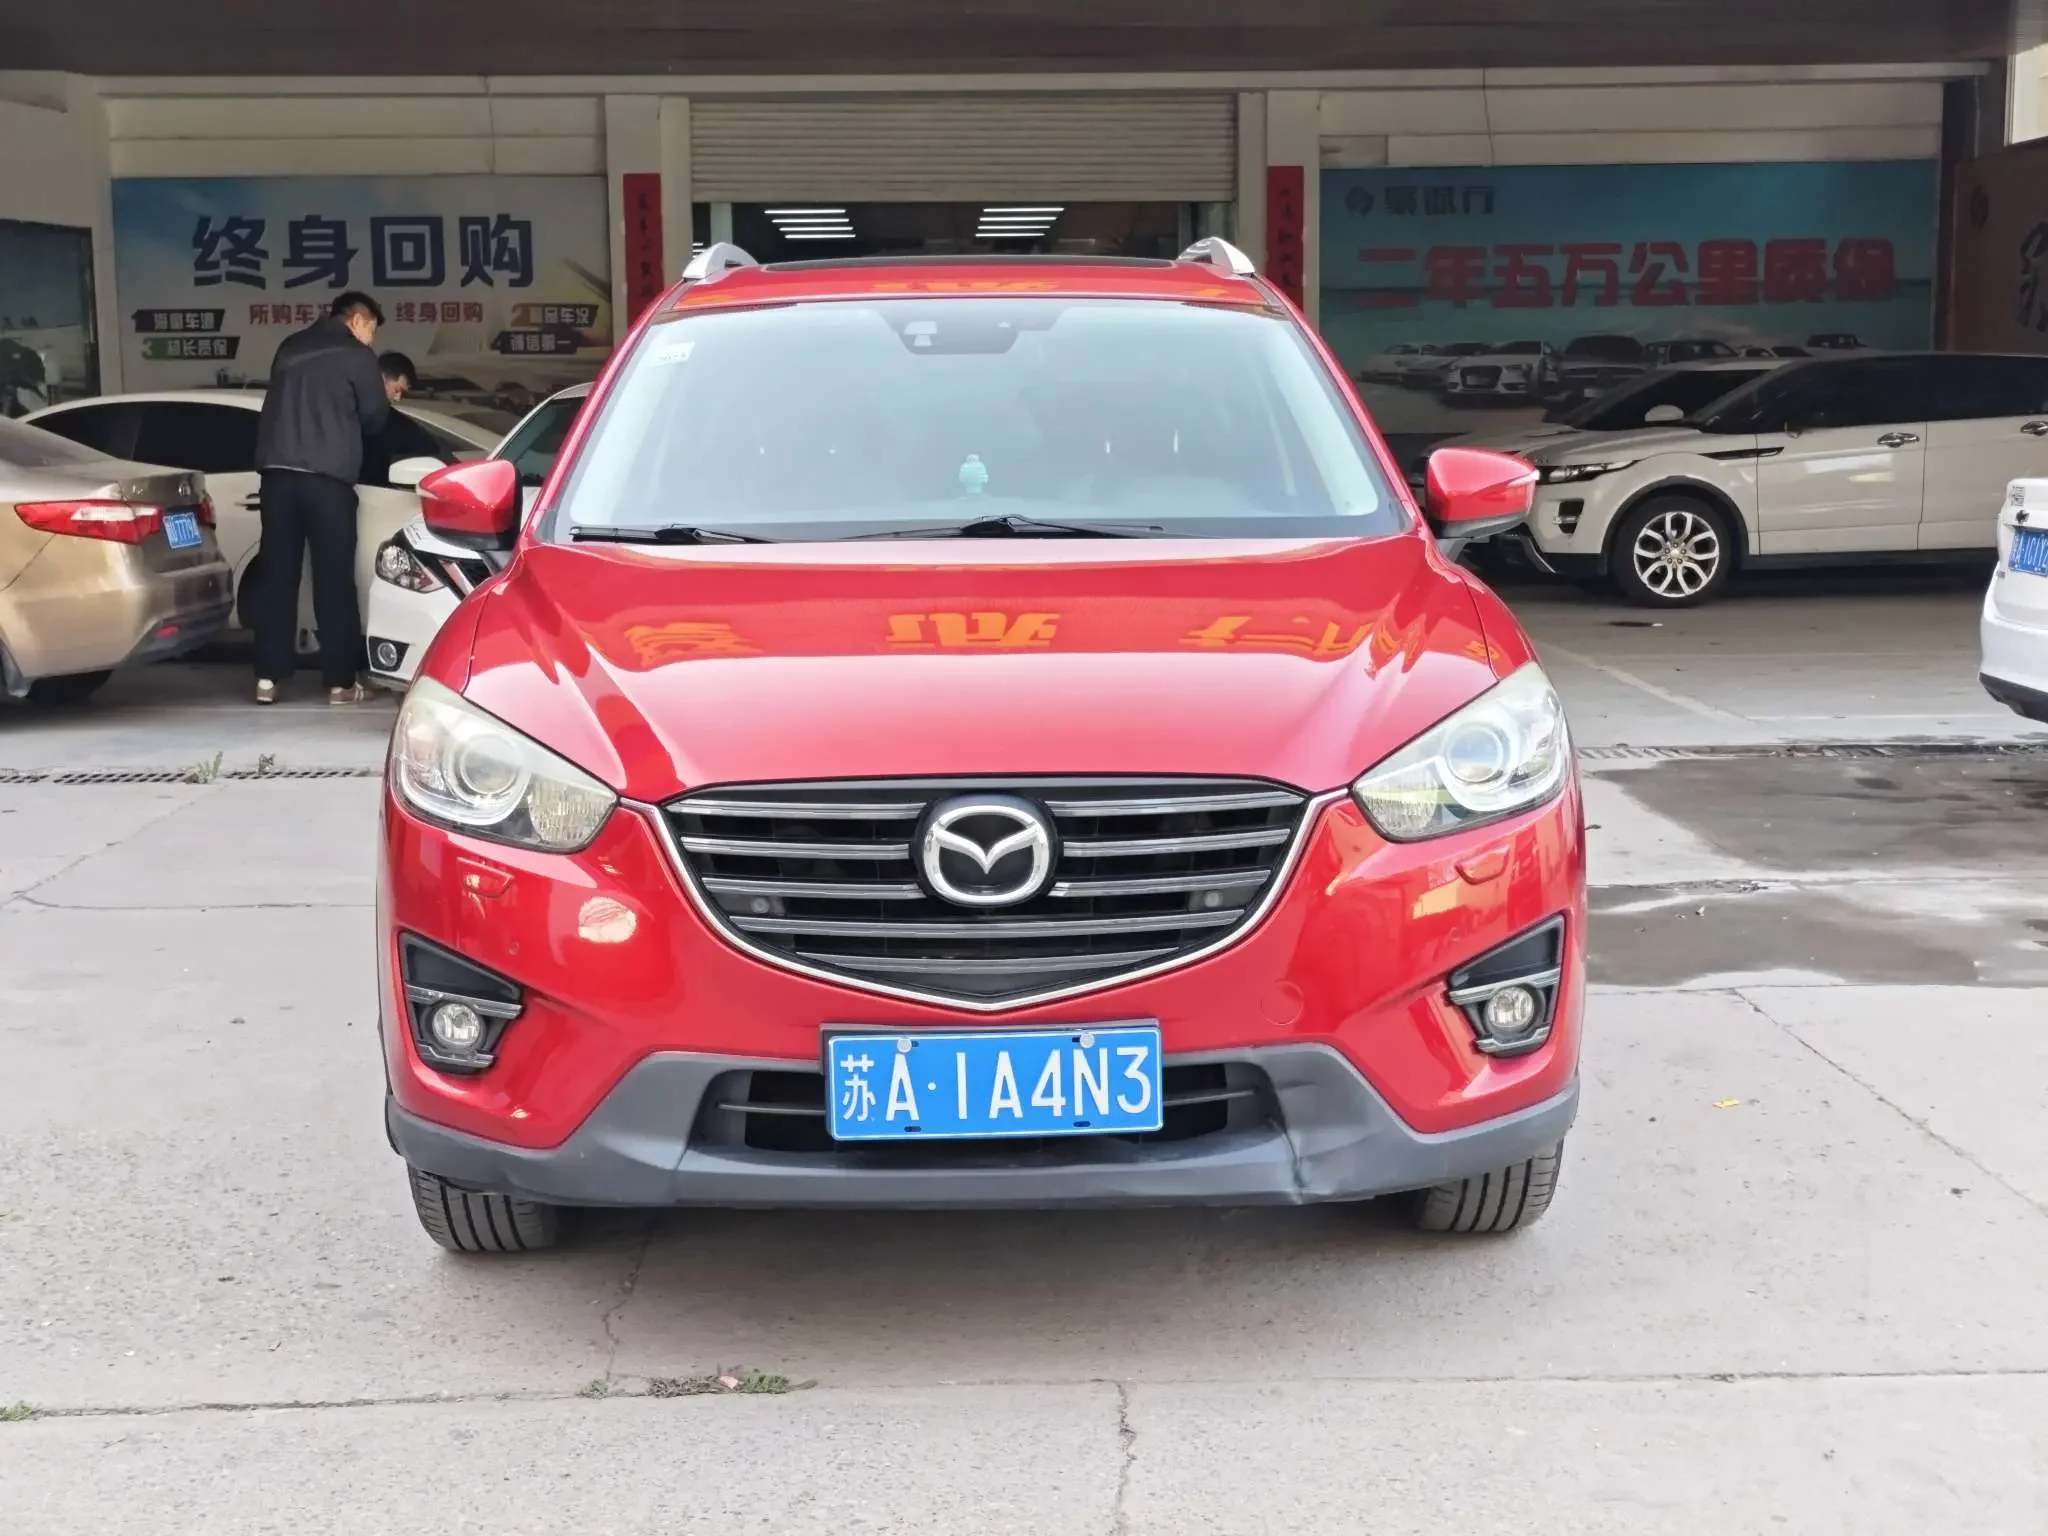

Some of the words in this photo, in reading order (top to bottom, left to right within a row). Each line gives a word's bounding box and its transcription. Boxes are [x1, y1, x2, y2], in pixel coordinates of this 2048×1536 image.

[191, 213, 534, 289] 终身回购
[396, 302, 484, 324] 终身回购
